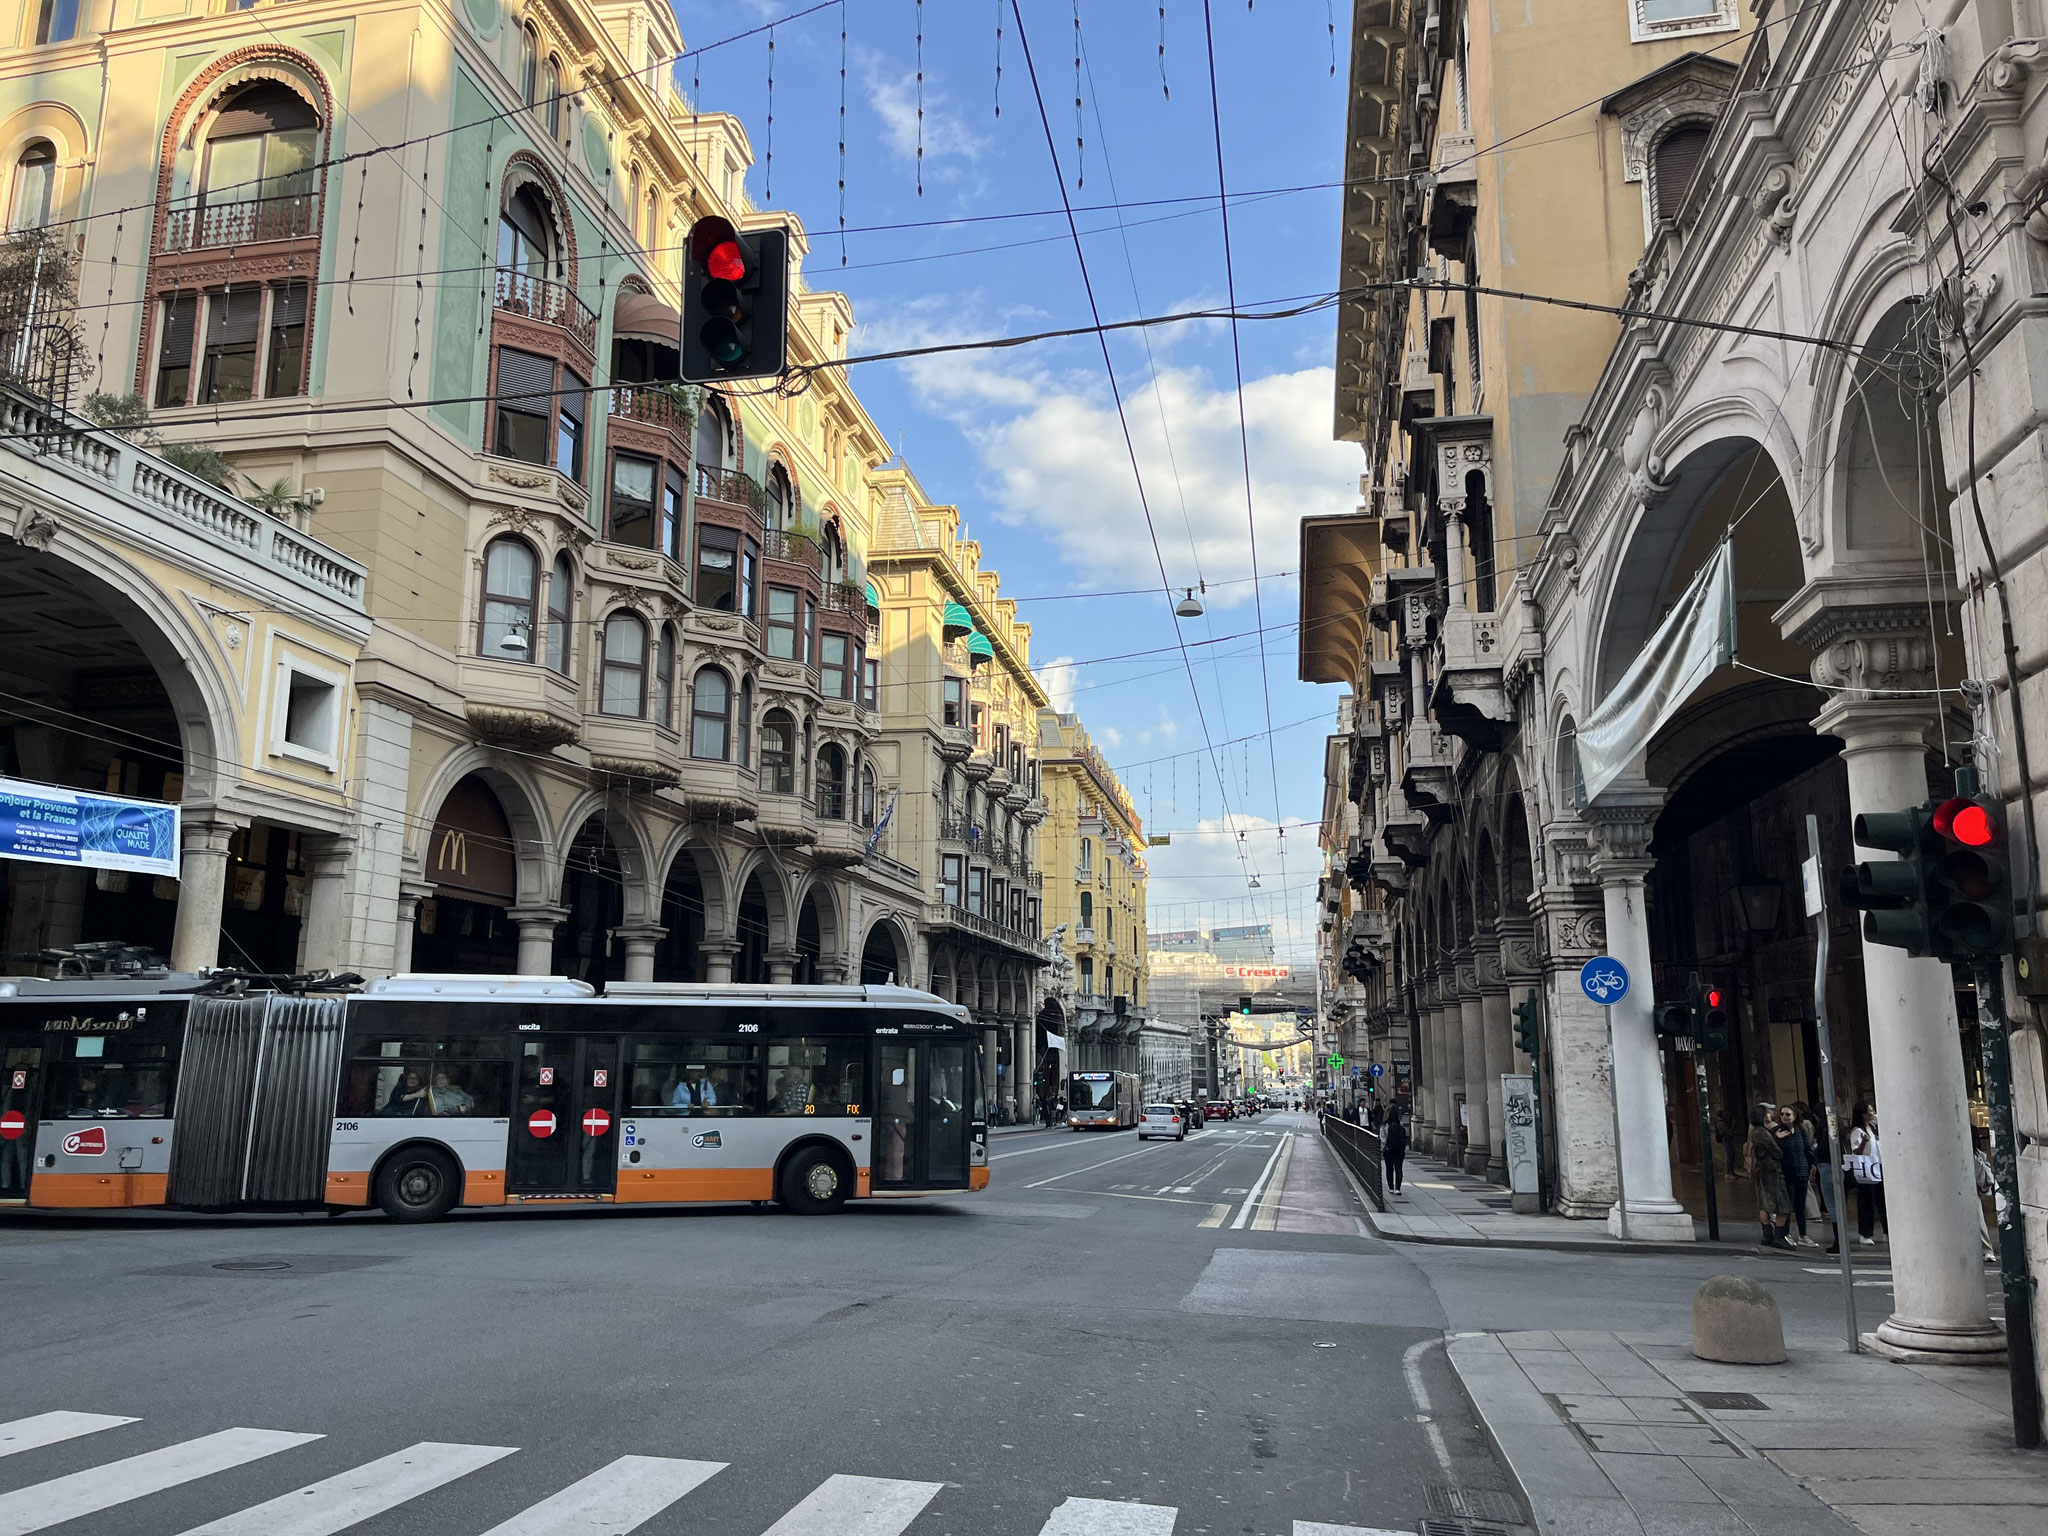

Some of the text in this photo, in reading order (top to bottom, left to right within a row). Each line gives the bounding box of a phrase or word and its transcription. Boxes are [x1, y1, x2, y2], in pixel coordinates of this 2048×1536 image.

[33, 800, 78, 815] Provence
[20, 810, 76, 826] et la France
[116, 829, 149, 840] QUALITY
[127, 839, 150, 850] MADE
[1238, 967, 1288, 977] Cresta
[518, 1023, 541, 1031] uscita
[738, 1023, 759, 1033] 2106
[875, 1027, 898, 1035] entrata
[336, 1121, 359, 1131] 2106
